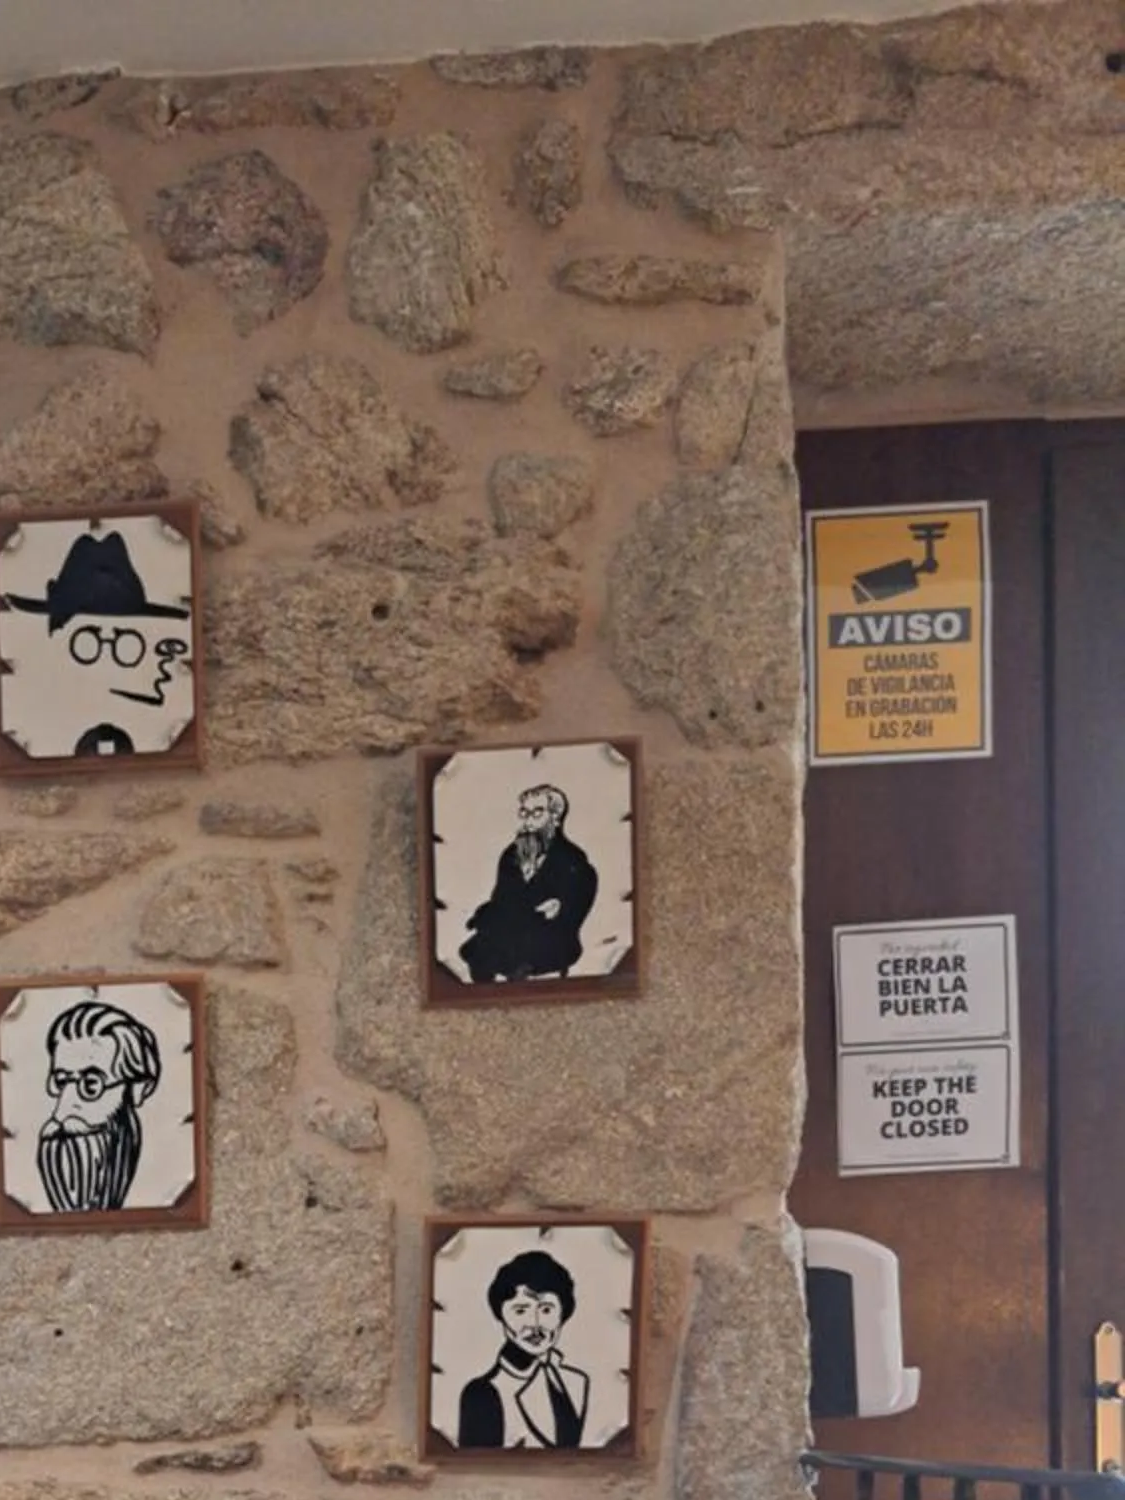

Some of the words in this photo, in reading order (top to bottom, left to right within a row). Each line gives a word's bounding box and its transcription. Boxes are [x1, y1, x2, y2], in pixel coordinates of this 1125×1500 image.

[838, 612, 963, 644] AVISO
[847, 677, 866, 696] DE
[870, 673, 955, 694] VIGILANCIA
[845, 699, 866, 718] EN
[869, 720, 899, 740] LAS
[902, 719, 933, 738] 24H
[877, 955, 967, 977] CERRAR
[878, 978, 931, 997] BIEN
[938, 976, 968, 994] LA
[879, 996, 968, 1017] PUERTA
[873, 1078, 927, 1099] KEEP
[933, 1076, 978, 1094] THE
[891, 1099, 960, 1118] DOOR
[880, 1118, 969, 1139] CLOSED
